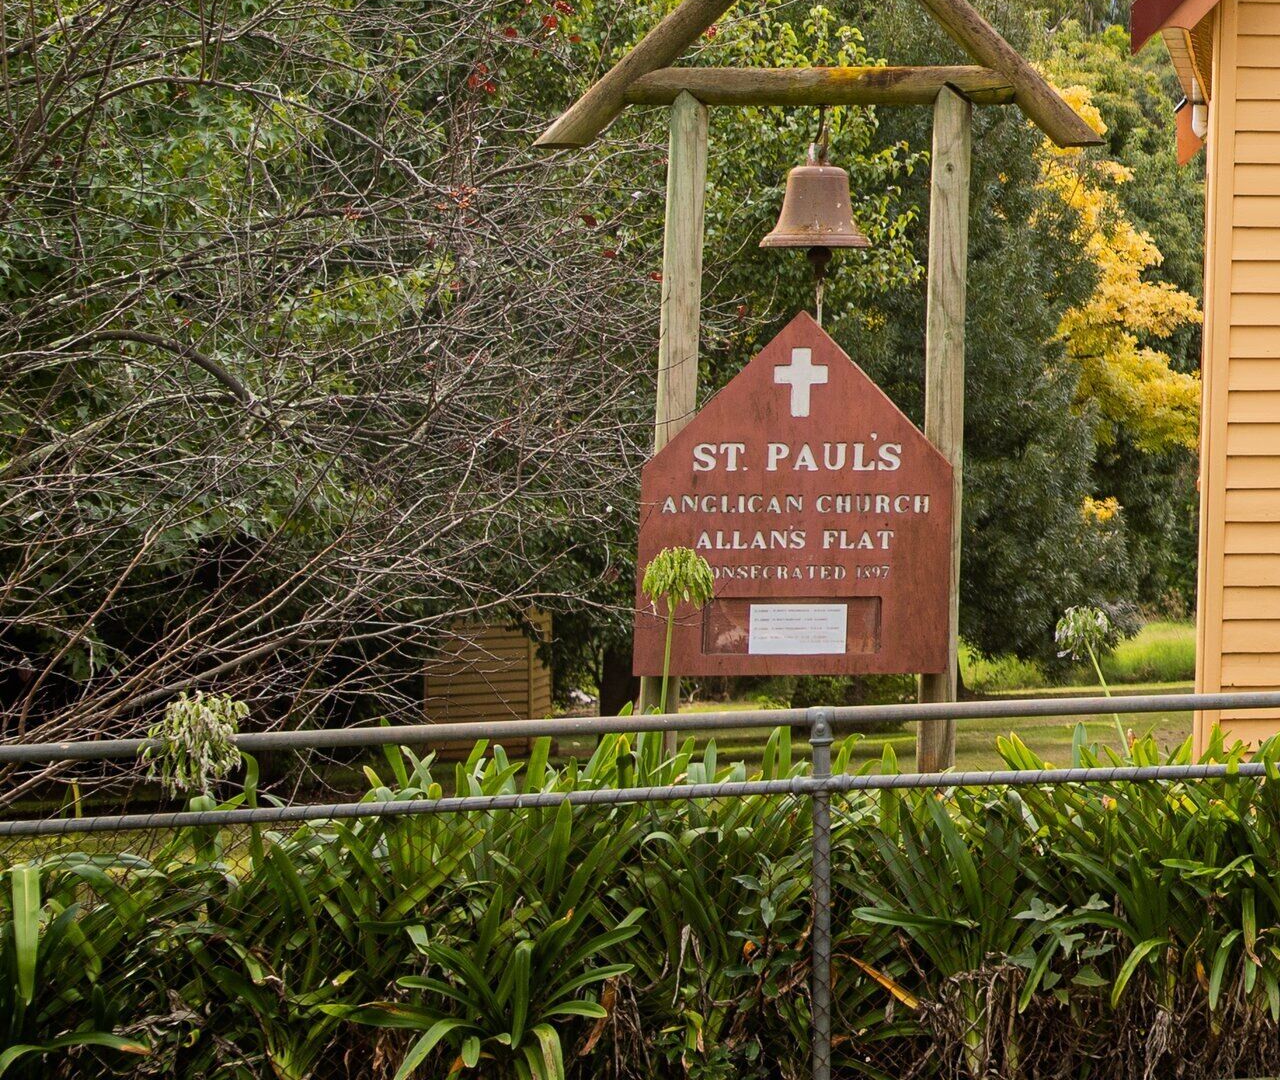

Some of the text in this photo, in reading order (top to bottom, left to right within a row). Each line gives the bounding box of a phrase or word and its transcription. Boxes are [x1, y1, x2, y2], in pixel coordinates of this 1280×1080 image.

[692, 432, 902, 471] ST. PAUL'S
[661, 494, 930, 514] ANGLICAN CHURCH
[696, 525, 894, 549] ALLAN'S FLAT
[710, 565, 890, 580] ONSECRATED 1897
